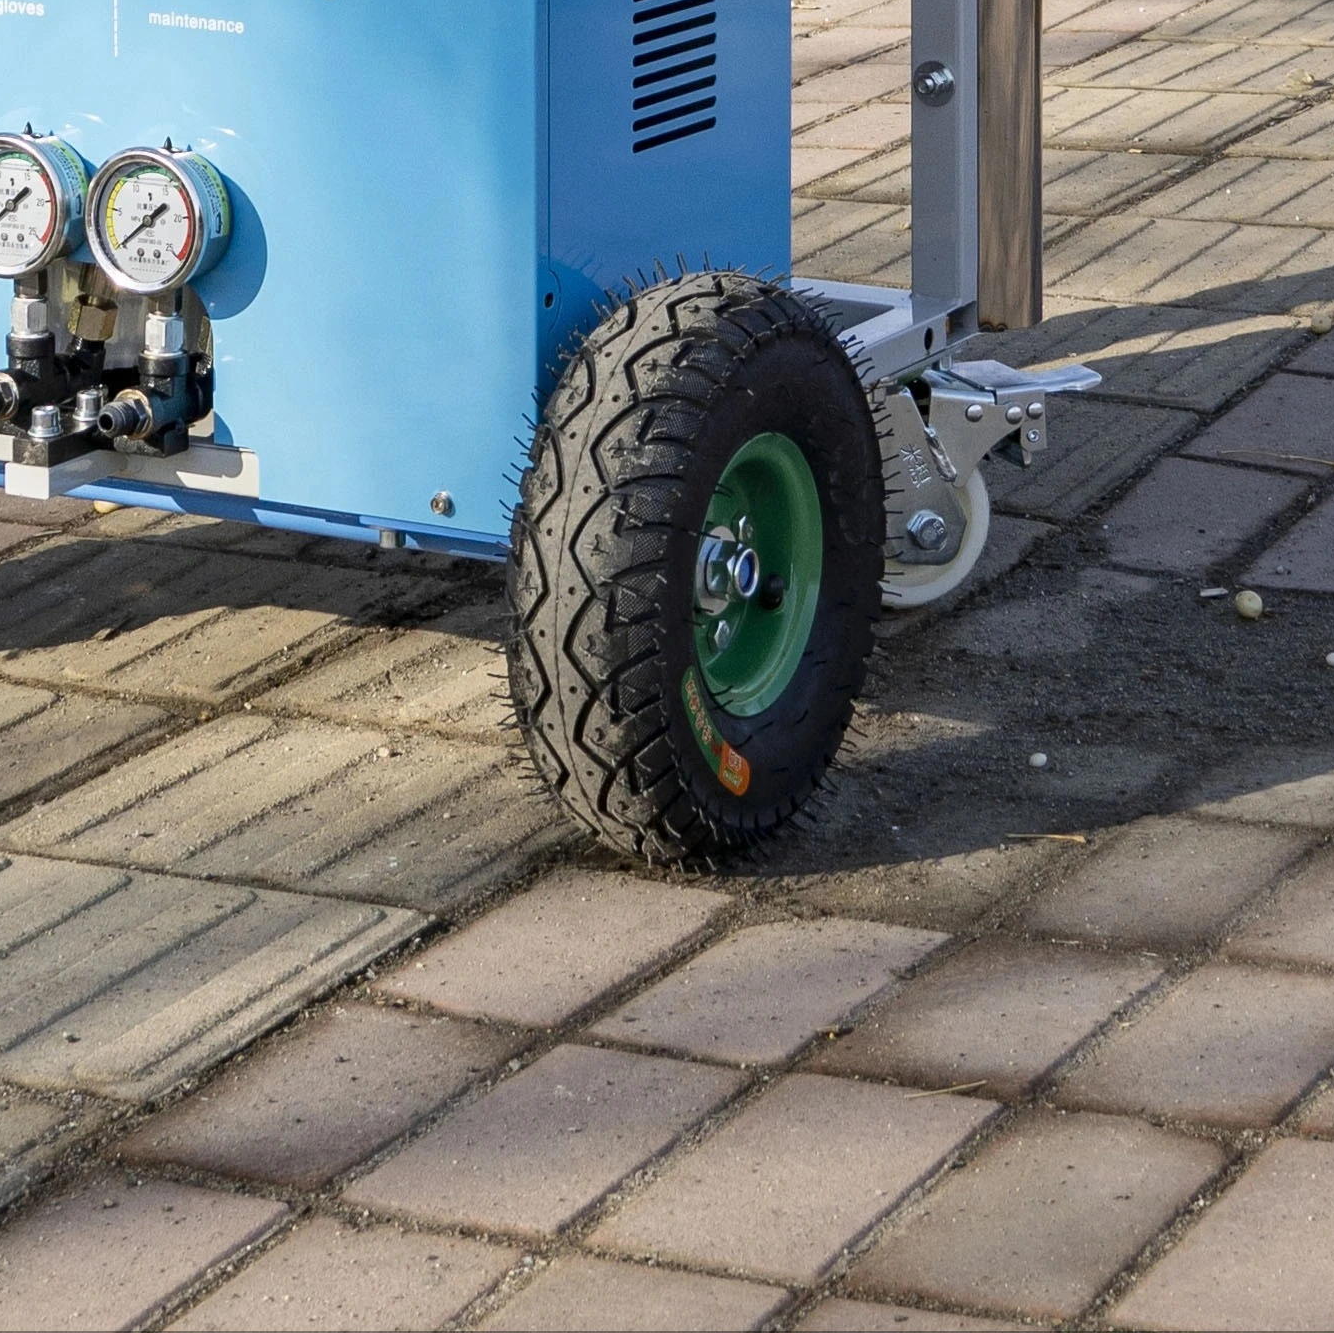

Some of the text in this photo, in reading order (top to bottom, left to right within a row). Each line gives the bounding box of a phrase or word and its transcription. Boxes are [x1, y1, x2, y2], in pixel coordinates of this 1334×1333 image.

[148, 11, 245, 35] maintenance
[36, 198, 45, 207] 20
[173, 214, 182, 223] 20
